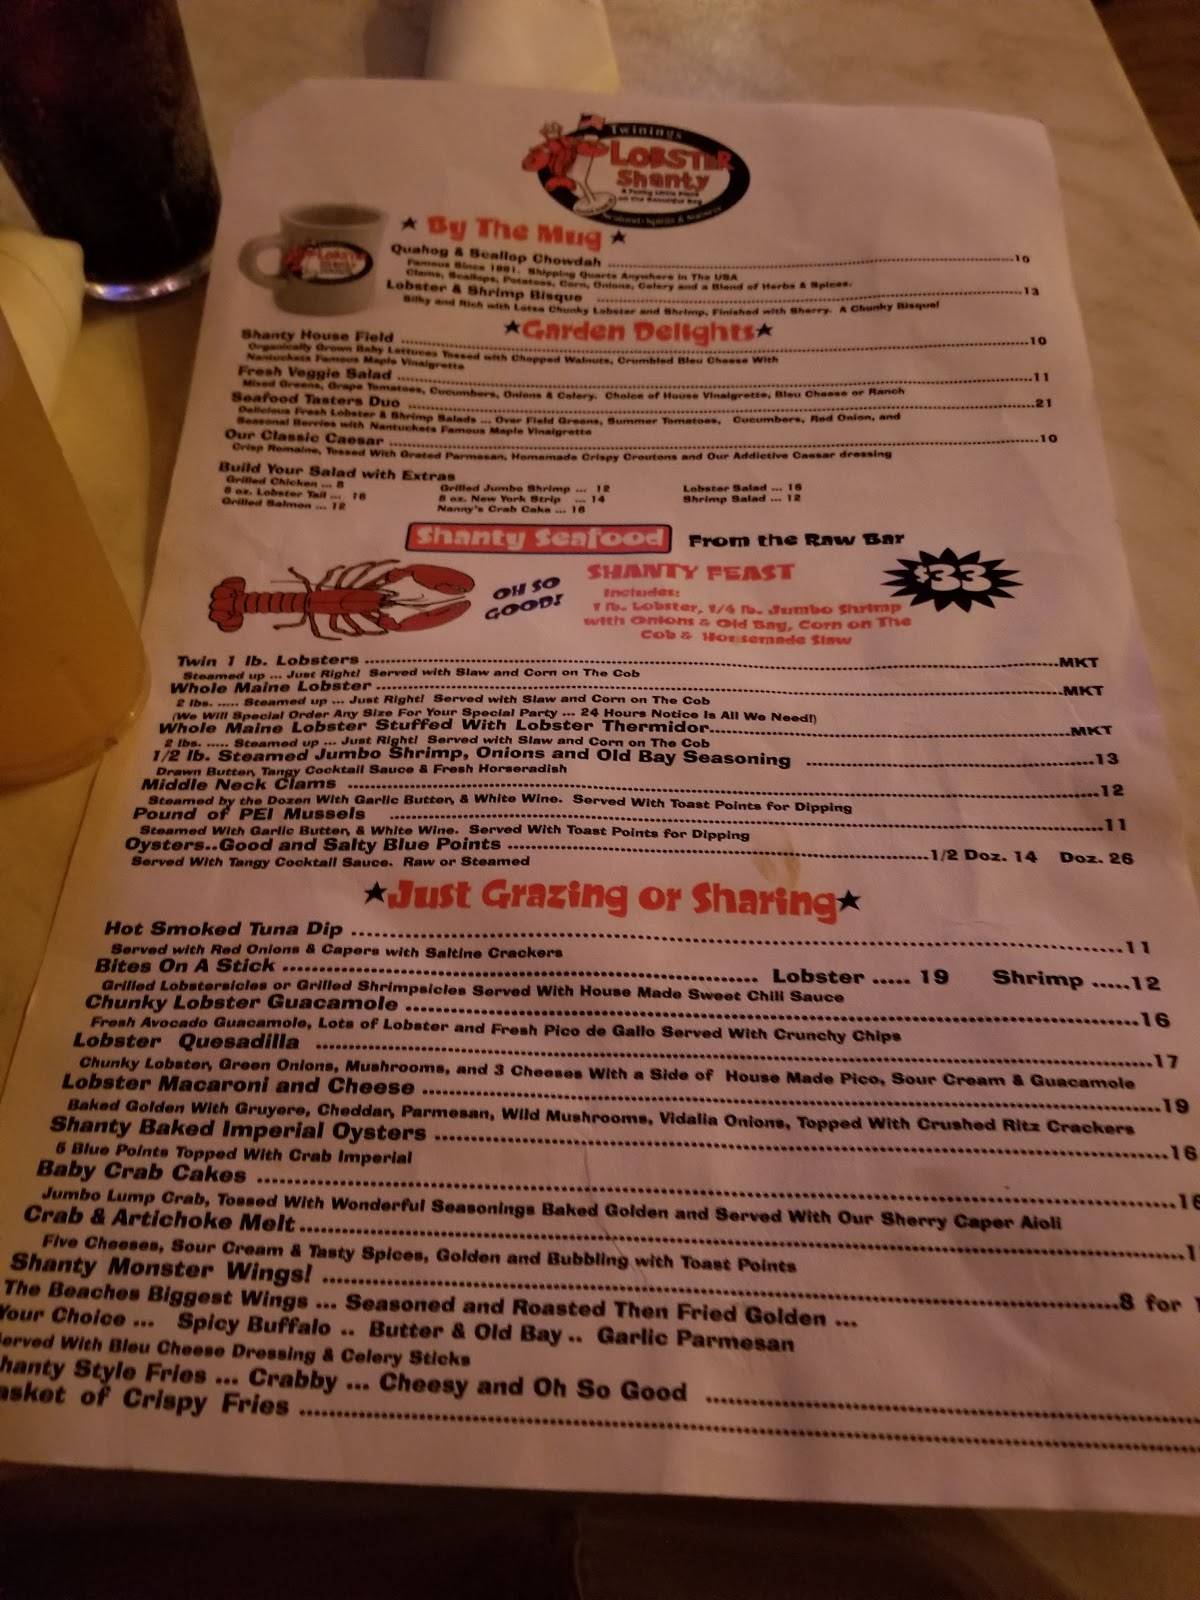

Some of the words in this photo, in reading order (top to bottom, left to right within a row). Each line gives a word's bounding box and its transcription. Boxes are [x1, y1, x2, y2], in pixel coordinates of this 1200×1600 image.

[610, 140, 733, 170] LOBSTER
[617, 169, 709, 191] Shanty
[427, 216, 468, 239] By
[476, 217, 528, 241] The
[537, 223, 602, 250] Mug
[391, 244, 448, 258] Quahog
[455, 247, 463, 257] &
[470, 248, 527, 264] Scallop
[533, 254, 601, 267] Chowdah
[387, 280, 447, 292] Lobster
[452, 284, 461, 294] &
[468, 285, 524, 301] Shrimp
[530, 290, 582, 304] Bisque
[242, 329, 295, 343] Shanty
[301, 330, 349, 341] House
[355, 331, 394, 343] Field
[522, 319, 625, 342] Garden
[633, 319, 755, 345] Delights
[238, 365, 282, 377] Fresh
[288, 366, 340, 381] Veggie
[346, 368, 392, 380] Salad
[225, 429, 255, 440] Our
[261, 430, 319, 443] Classic
[325, 432, 384, 446] Caesar
[219, 461, 261, 473] Build
[268, 463, 303, 475] Your
[309, 466, 356, 478] Salad
[362, 469, 396, 479] with
[402, 470, 455, 481] Extras
[417, 526, 526, 550] Shanty
[535, 526, 664, 548] Seafood
[689, 534, 749, 548] From
[758, 533, 797, 547] the
[805, 533, 855, 547] Raw
[865, 533, 904, 546] Bar
[587, 563, 698, 580] SHANTY
[707, 563, 795, 580] FEAST
[913, 564, 992, 592] $33
[493, 584, 527, 600] OH
[531, 577, 560, 592] SO
[484, 593, 563, 620] GOOD!
[178, 656, 217, 667] Twin
[228, 656, 235, 666] 1
[245, 656, 267, 666] lb.
[276, 655, 359, 666] Lobsters
[160, 722, 216, 734] Whole
[225, 722, 283, 734] Maine
[292, 720, 367, 733] Lobster
[376, 718, 453, 730] Stuffed
[462, 718, 506, 730] With
[516, 719, 593, 731] Lobster
[602, 720, 709, 733] Thermidor
[153, 749, 180, 762] 1/2
[187, 749, 210, 761] lb.
[218, 749, 309, 762] Steamed
[311, 747, 381, 760] Jumbo
[389, 745, 468, 761] Shrimp,
[476, 746, 545, 758] Onions
[552, 748, 589, 760] and
[597, 749, 631, 761] Old
[639, 750, 676, 766] Bay
[683, 750, 791, 769] Seasoning
[133, 807, 197, 820] Pound
[207, 806, 230, 820] of
[239, 808, 273, 820] PEI
[284, 807, 365, 820] Mussels
[278, 838, 317, 851] and
[323, 837, 377, 854] Salty
[383, 838, 429, 851] Blue
[436, 837, 501, 850] Points
[931, 849, 958, 861] 1/2
[964, 849, 1007, 861] Doz.
[1060, 852, 1103, 863] Doz.
[131, 856, 185, 866] Served
[190, 857, 223, 867] With
[229, 857, 270, 869] Tangy
[275, 857, 337, 867] Cocktail
[342, 857, 393, 867] Sauce.
[403, 857, 435, 867] Raw
[461, 856, 530, 866] Steamed
[387, 881, 471, 909] Just
[482, 879, 628, 917] Grazing
[639, 887, 681, 910] or
[692, 883, 837, 924] Sharing
[105, 921, 143, 936] Hot
[150, 921, 242, 936] Smoked
[250, 922, 298, 936] Tuna
[307, 921, 343, 939] Dip
[95, 958, 151, 973] Bites
[159, 958, 188, 973] On
[194, 958, 208, 972] A
[216, 958, 275, 973] Stick
[772, 970, 865, 985] Lobster
[993, 970, 1084, 990] Shrimp
[85, 994, 168, 1013] Chunky
[173, 994, 261, 1010] Lobster
[267, 994, 398, 1011] Guacamole
[91, 1016, 135, 1028] Fresh
[140, 1017, 208, 1028] Avocado
[214, 1016, 312, 1030] Guacamole,
[318, 1017, 354, 1029] Lots
[360, 1018, 379, 1029] of
[383, 1018, 449, 1031] Lobster
[454, 1023, 485, 1034] and
[491, 1023, 537, 1036] Fresh
[544, 1024, 580, 1036] Pico
[586, 1024, 606, 1037] de
[612, 1024, 655, 1037] Gallo
[661, 1026, 722, 1039] Served
[728, 1028, 767, 1039] With
[774, 1028, 846, 1044] Crunchy
[852, 1030, 901, 1044] Chips
[73, 1032, 161, 1048] Lobster
[179, 1033, 299, 1052] Quesadilla
[50, 1116, 131, 1138] Shanty
[139, 1118, 215, 1136] Baked
[223, 1120, 324, 1142] Imperial
[333, 1122, 426, 1144] Oysters
[24, 1205, 83, 1224] Crab
[90, 1208, 105, 1225] &
[111, 1208, 232, 1230] Artichoke
[239, 1213, 295, 1232] Melt
[597, 1326, 668, 1346] Garlic
[677, 1329, 794, 1352] Parmesan
